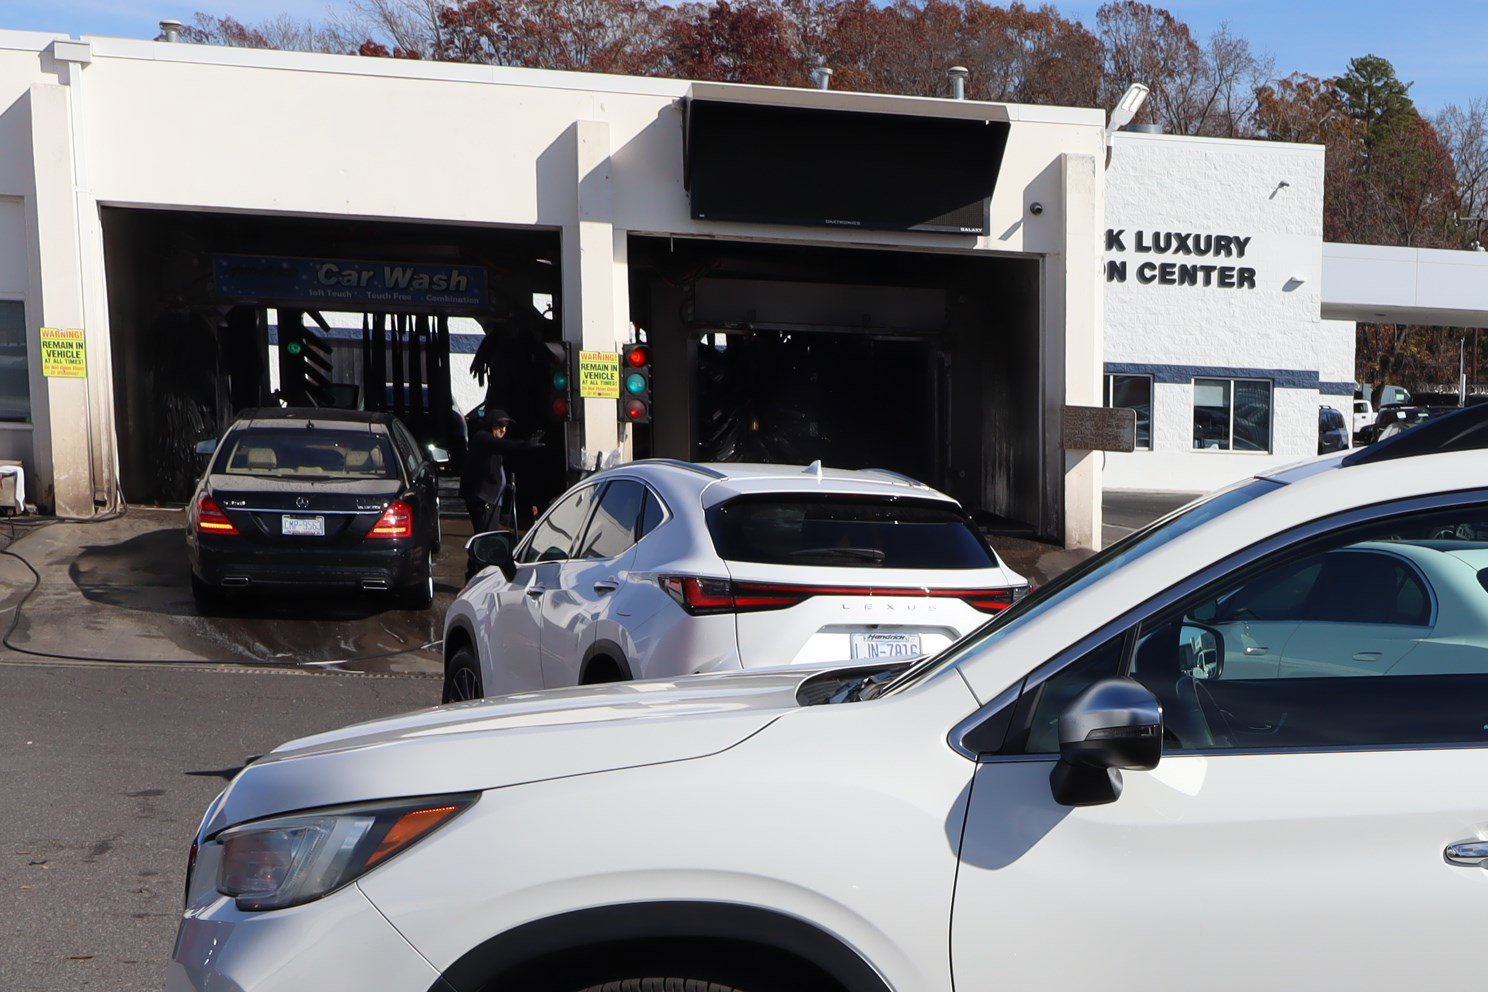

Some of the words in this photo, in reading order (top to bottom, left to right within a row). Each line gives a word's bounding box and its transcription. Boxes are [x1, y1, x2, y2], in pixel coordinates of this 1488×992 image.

[1134, 230, 1252, 258] LUXURY
[317, 263, 374, 287] Car
[384, 266, 469, 291] Wash
[1104, 260, 1127, 283] N
[1136, 261, 1256, 289] CENTER
[327, 289, 352, 298] Touch
[366, 291, 391, 300] Touch
[425, 294, 480, 304] Combination
[42, 330, 82, 338] WARNING!
[43, 341, 73, 349] REMAIN
[46, 350, 81, 358] VEHICLE
[581, 353, 617, 361] WARNING!
[580, 363, 608, 371] REMAIN
[584, 372, 615, 380] VEHICLE
[284, 518, 323, 530] CMP-9563
